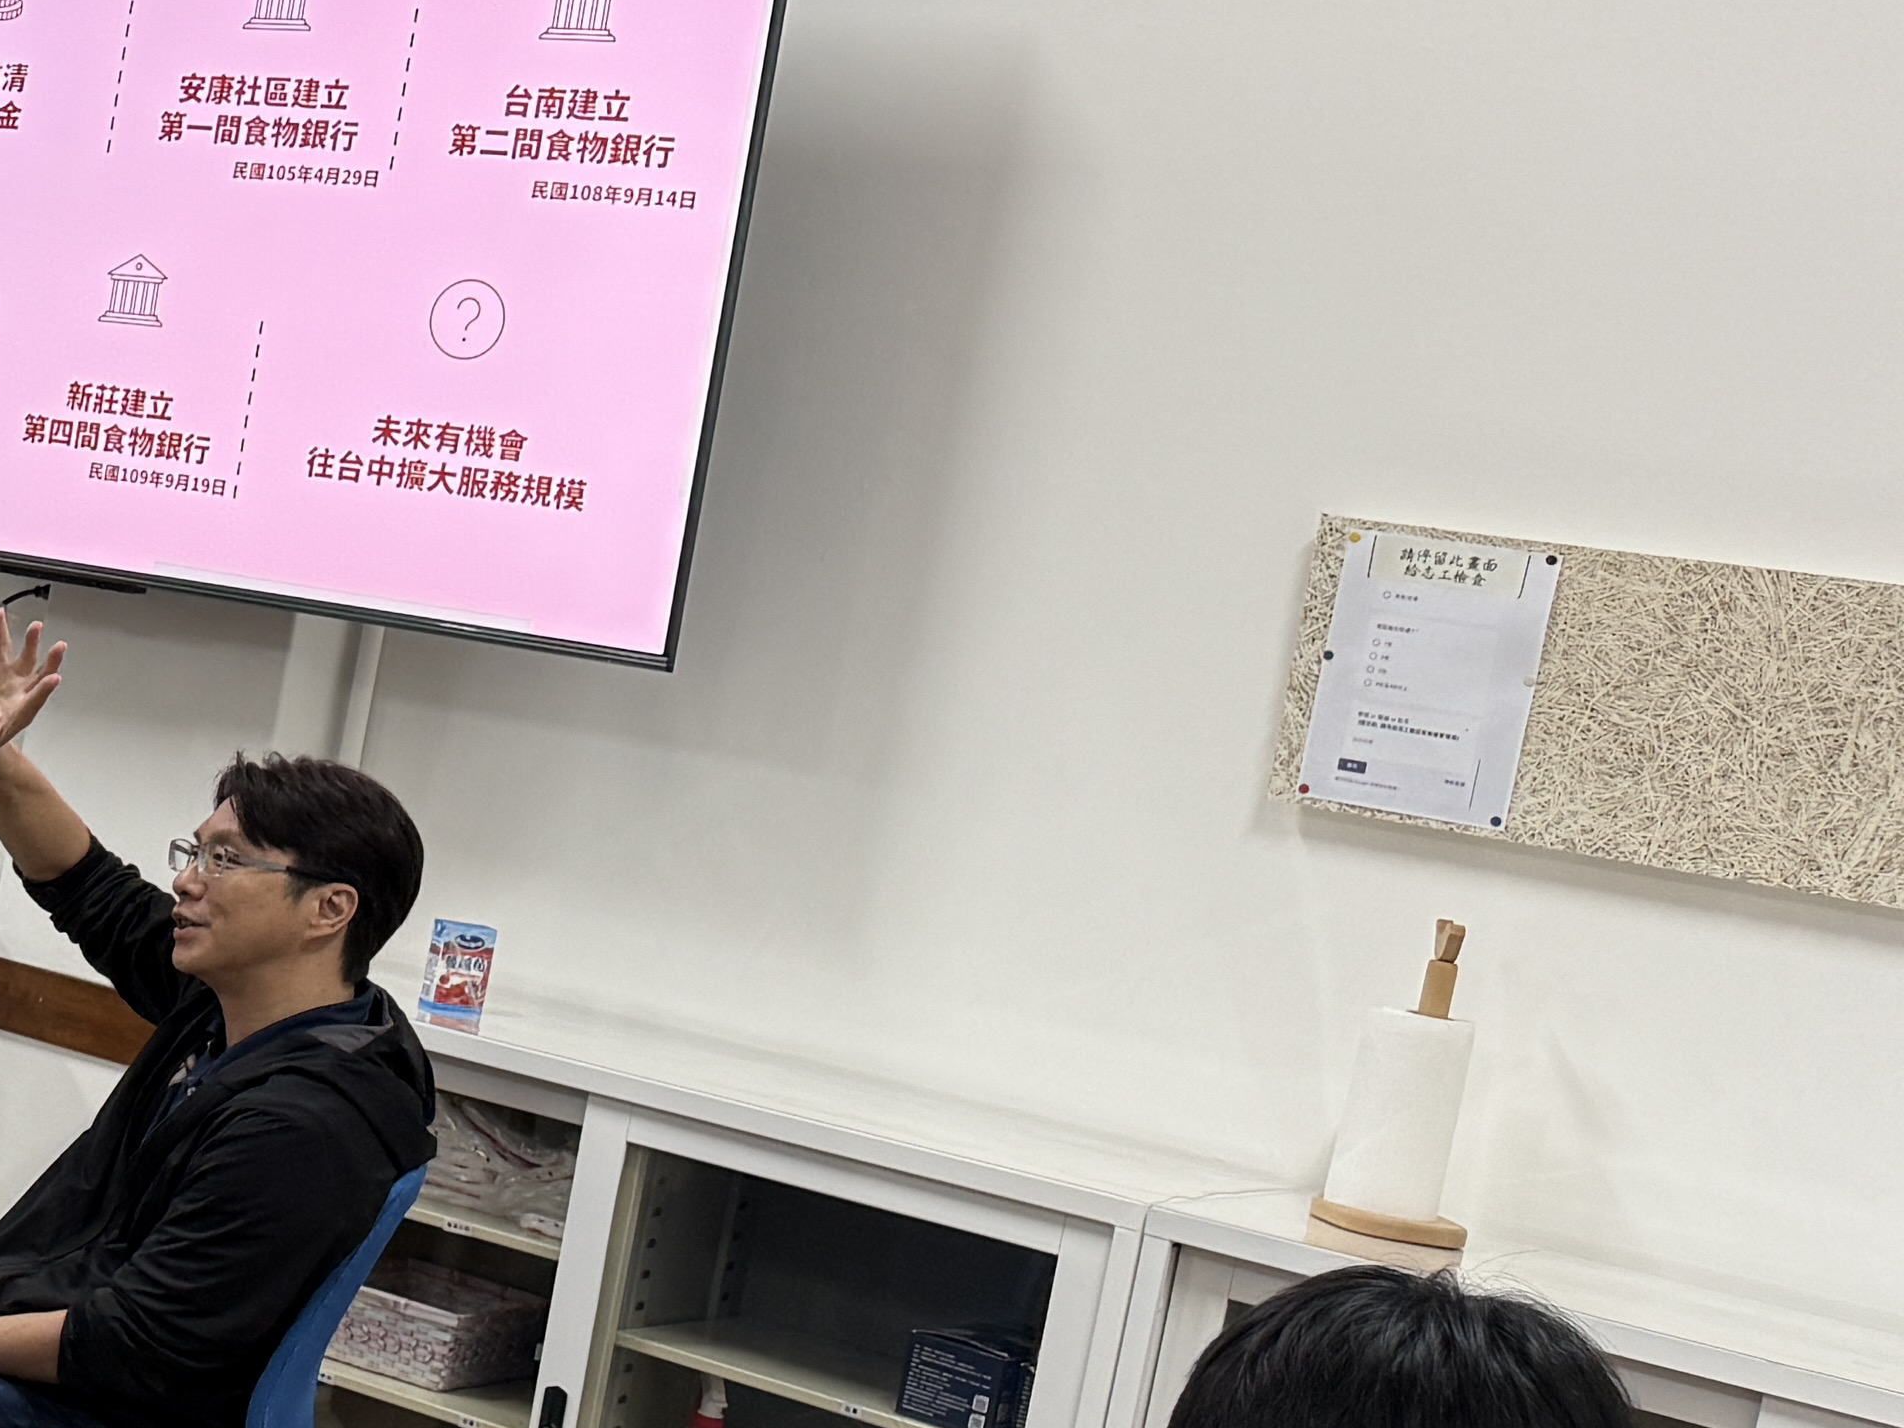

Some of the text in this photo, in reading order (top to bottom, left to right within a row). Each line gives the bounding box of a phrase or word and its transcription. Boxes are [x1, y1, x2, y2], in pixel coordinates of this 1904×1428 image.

[179, 73, 349, 110] 安康社區建立
[504, 84, 630, 122] 台南建立
[158, 110, 359, 152] 第一間食物銀行
[449, 123, 675, 168] 第二間食物銀行
[232, 162, 379, 188] 民國105年4月29日
[531, 180, 696, 209] 民國108年9月14日
[67, 381, 173, 421] 新莊建立
[23, 413, 210, 464] 第四間食物銀行
[372, 414, 528, 462] 未來有機會
[89, 462, 226, 496] 民國109年9月19日
[307, 446, 587, 512] 往台中擴大服務規模
